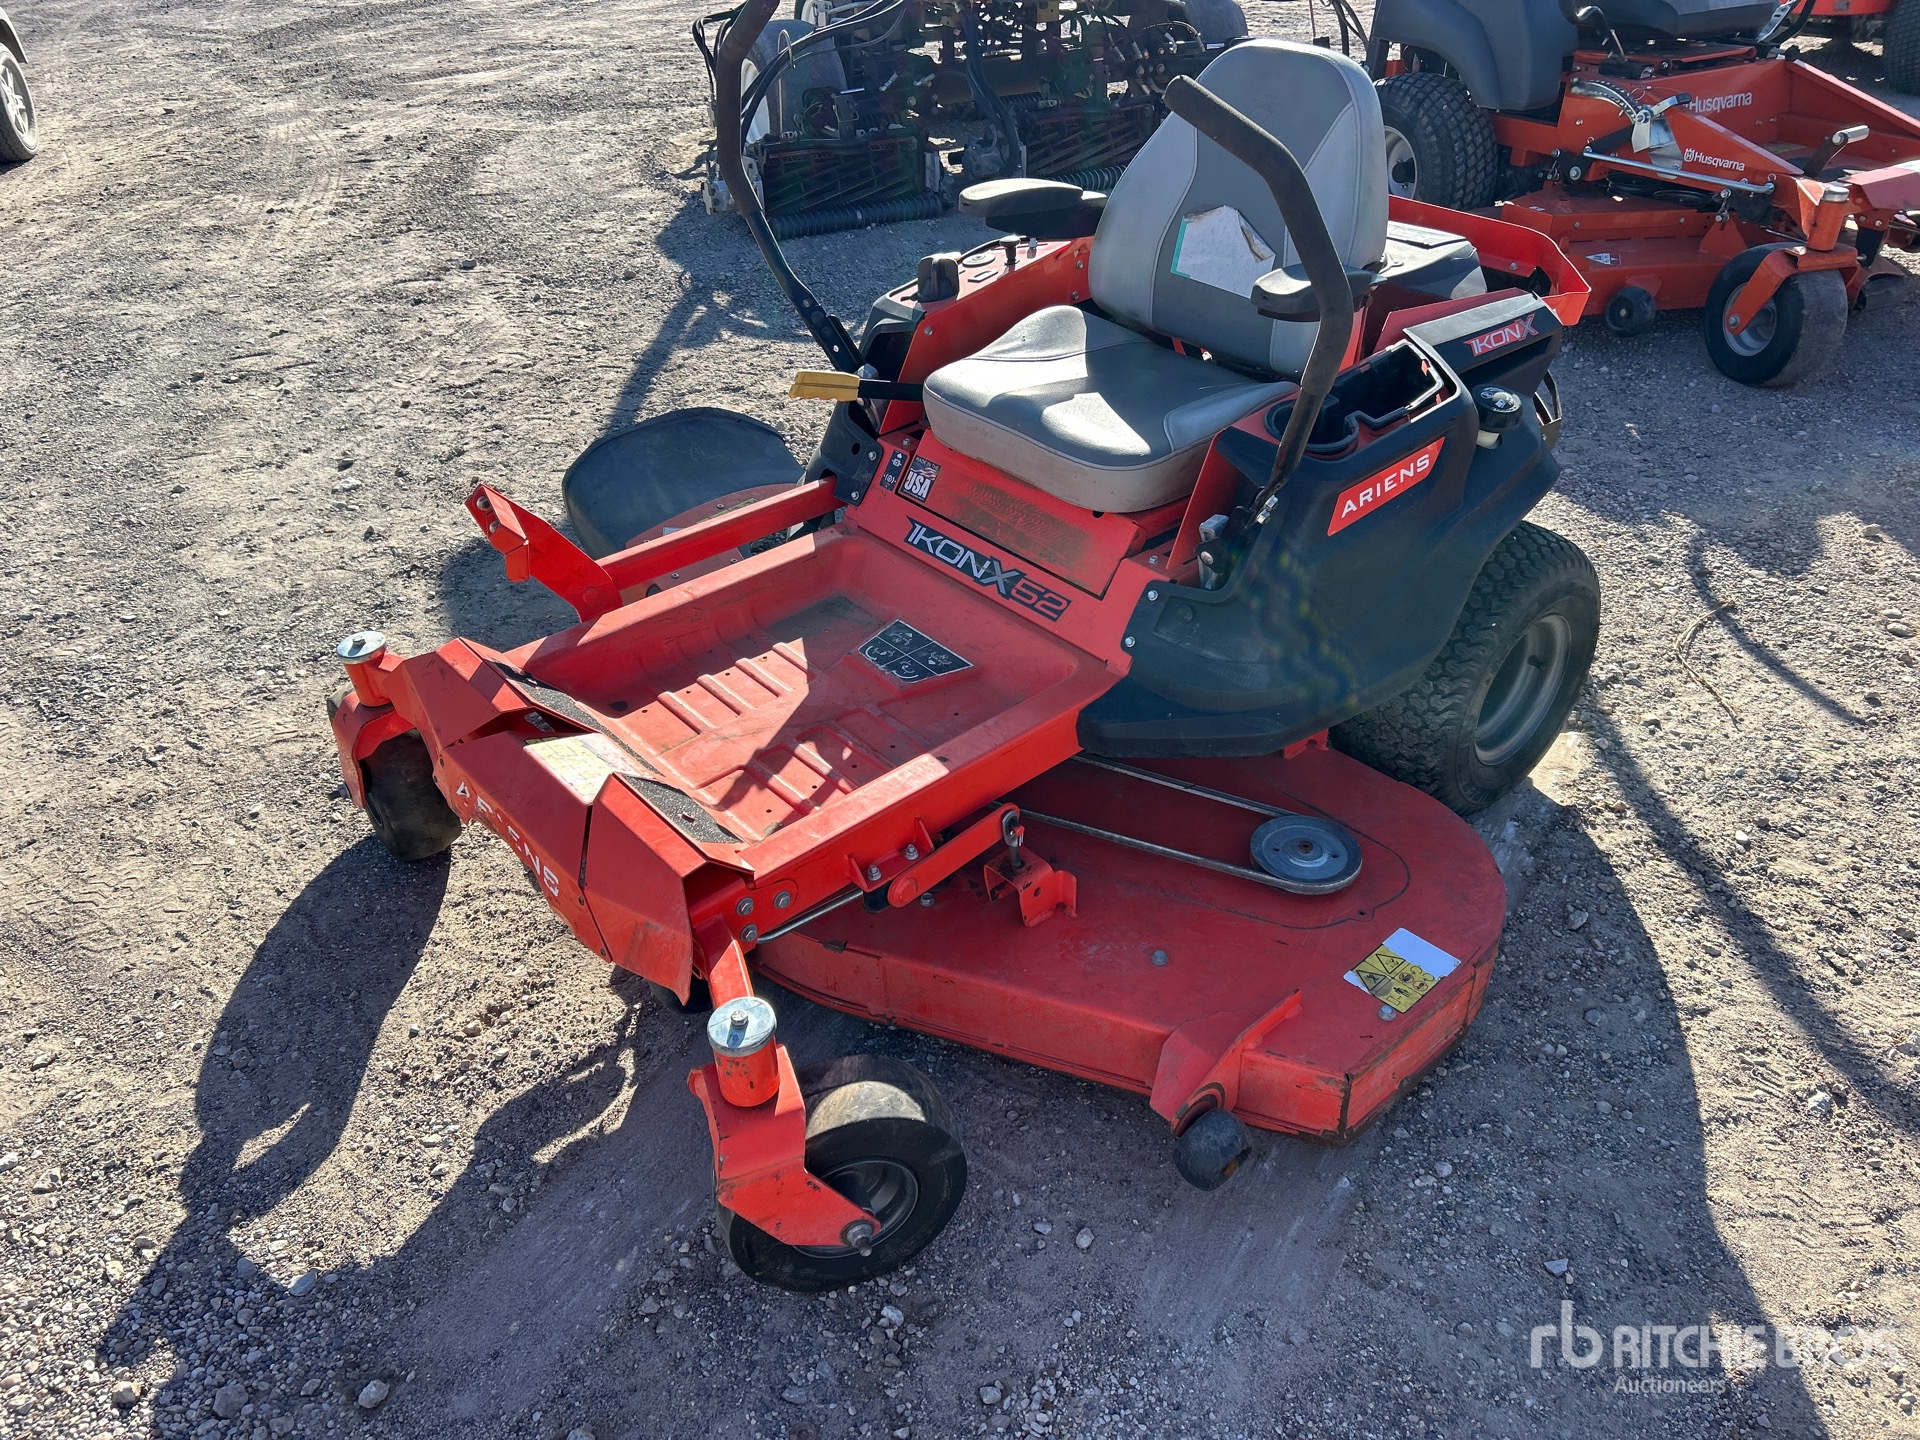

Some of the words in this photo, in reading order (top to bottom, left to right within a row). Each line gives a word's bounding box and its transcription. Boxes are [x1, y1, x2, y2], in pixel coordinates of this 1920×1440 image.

[1690, 92, 1752, 113] Husqvarna
[1694, 151, 1745, 171] Husqvarna
[904, 471, 931, 499] USA
[1341, 454, 1430, 519] ARIENS
